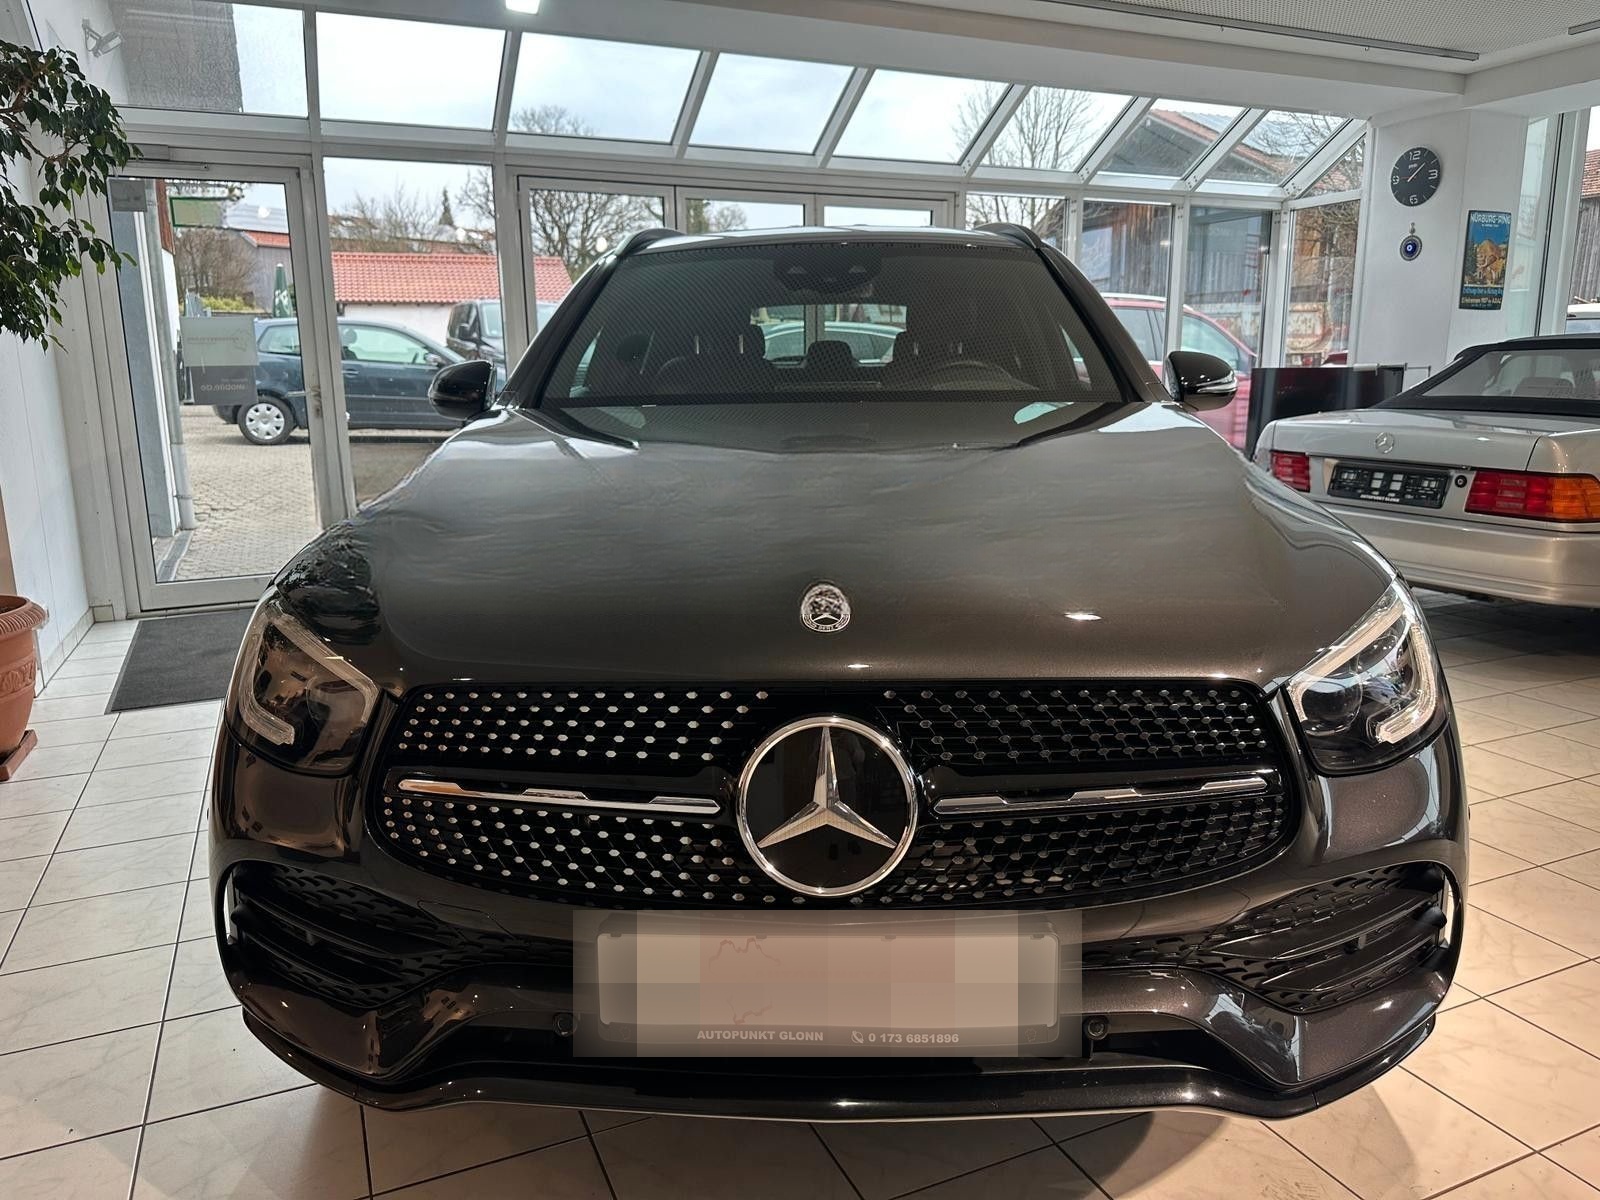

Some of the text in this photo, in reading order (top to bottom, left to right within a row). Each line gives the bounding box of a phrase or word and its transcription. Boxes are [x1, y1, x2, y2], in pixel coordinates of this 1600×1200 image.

[1410, 151, 1420, 160] 12
[1428, 169, 1437, 179] 3
[1392, 176, 1399, 184] 9
[1410, 195, 1418, 204] 6
[697, 1030, 824, 1041] AUTOPUNKT GLONN
[868, 1032, 960, 1044] 0 173 6851896
